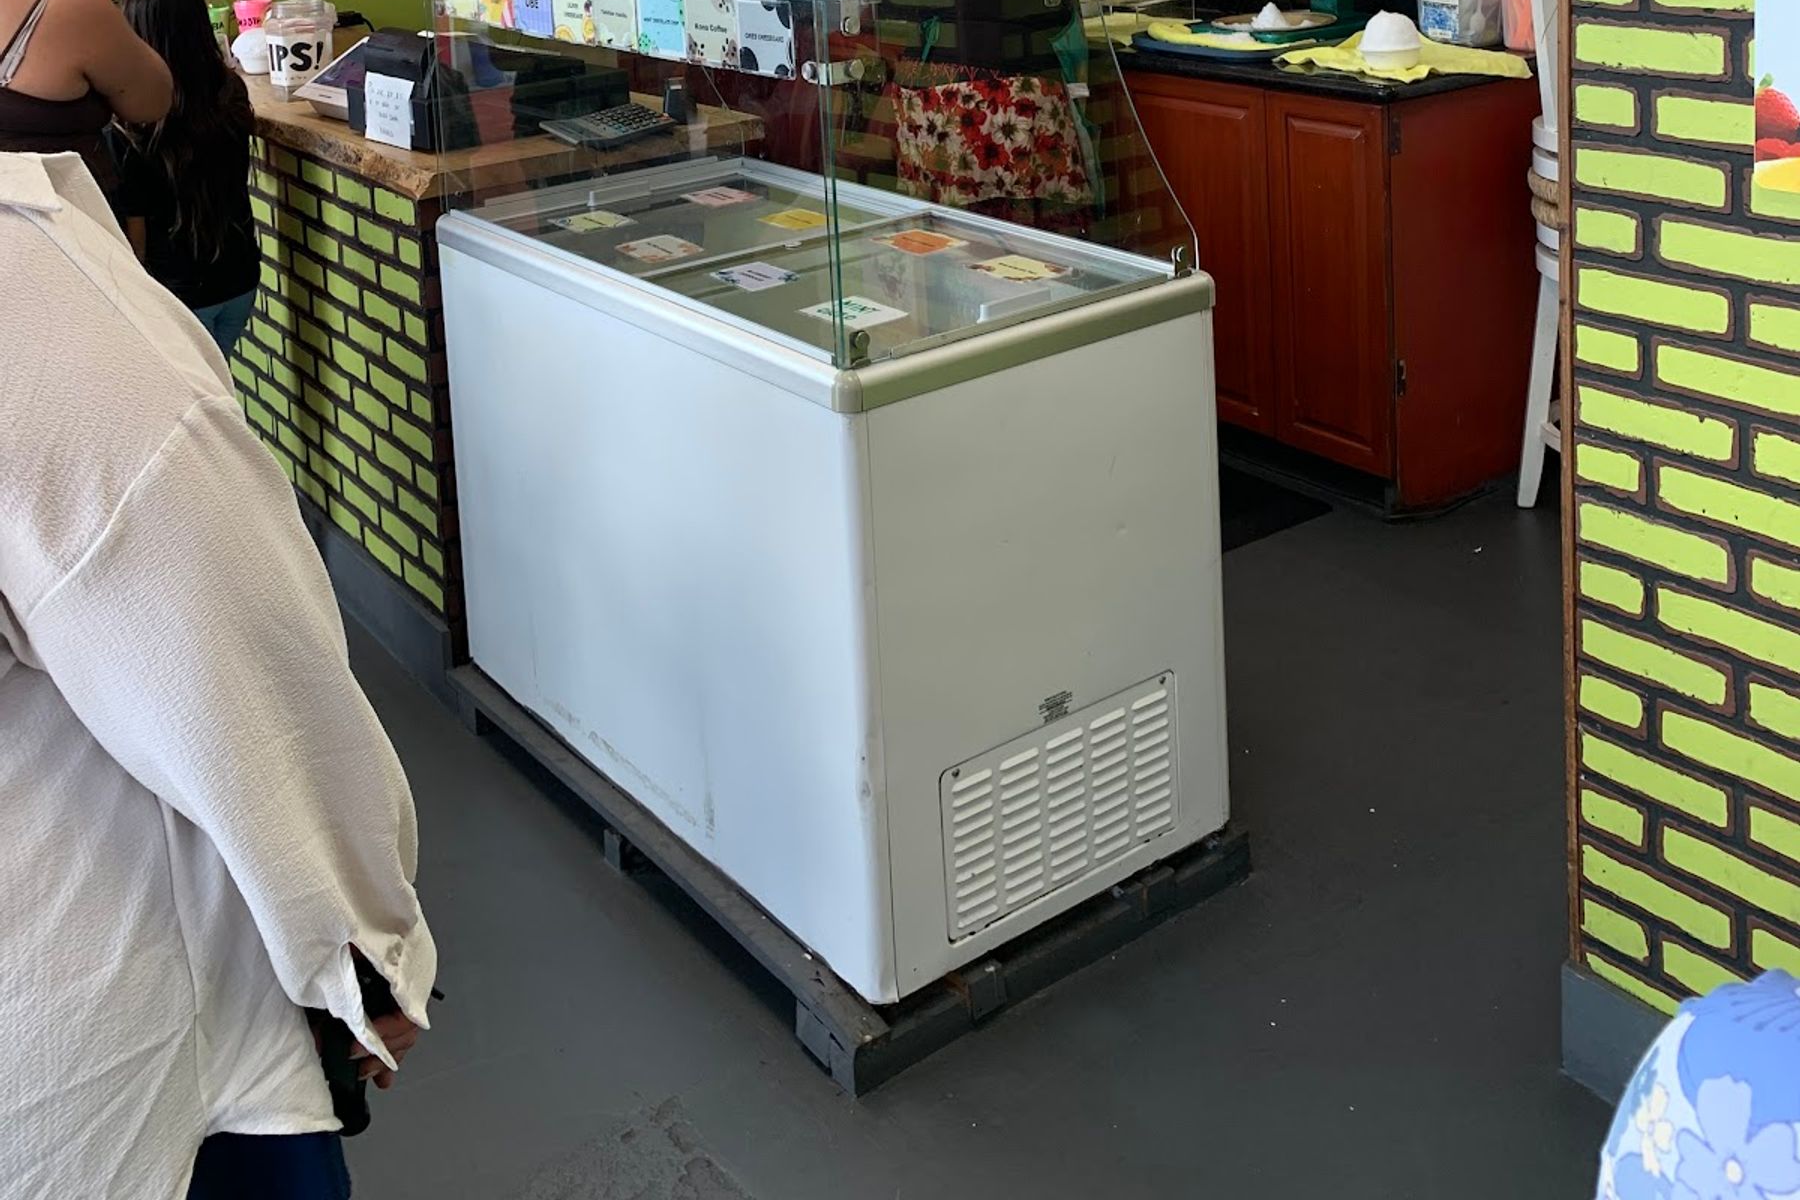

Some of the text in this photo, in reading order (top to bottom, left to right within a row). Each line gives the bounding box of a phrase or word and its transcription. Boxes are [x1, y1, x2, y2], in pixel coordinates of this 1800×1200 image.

[694, 23, 728, 34] Kona Coffee
[269, 41, 324, 72] IPS!
